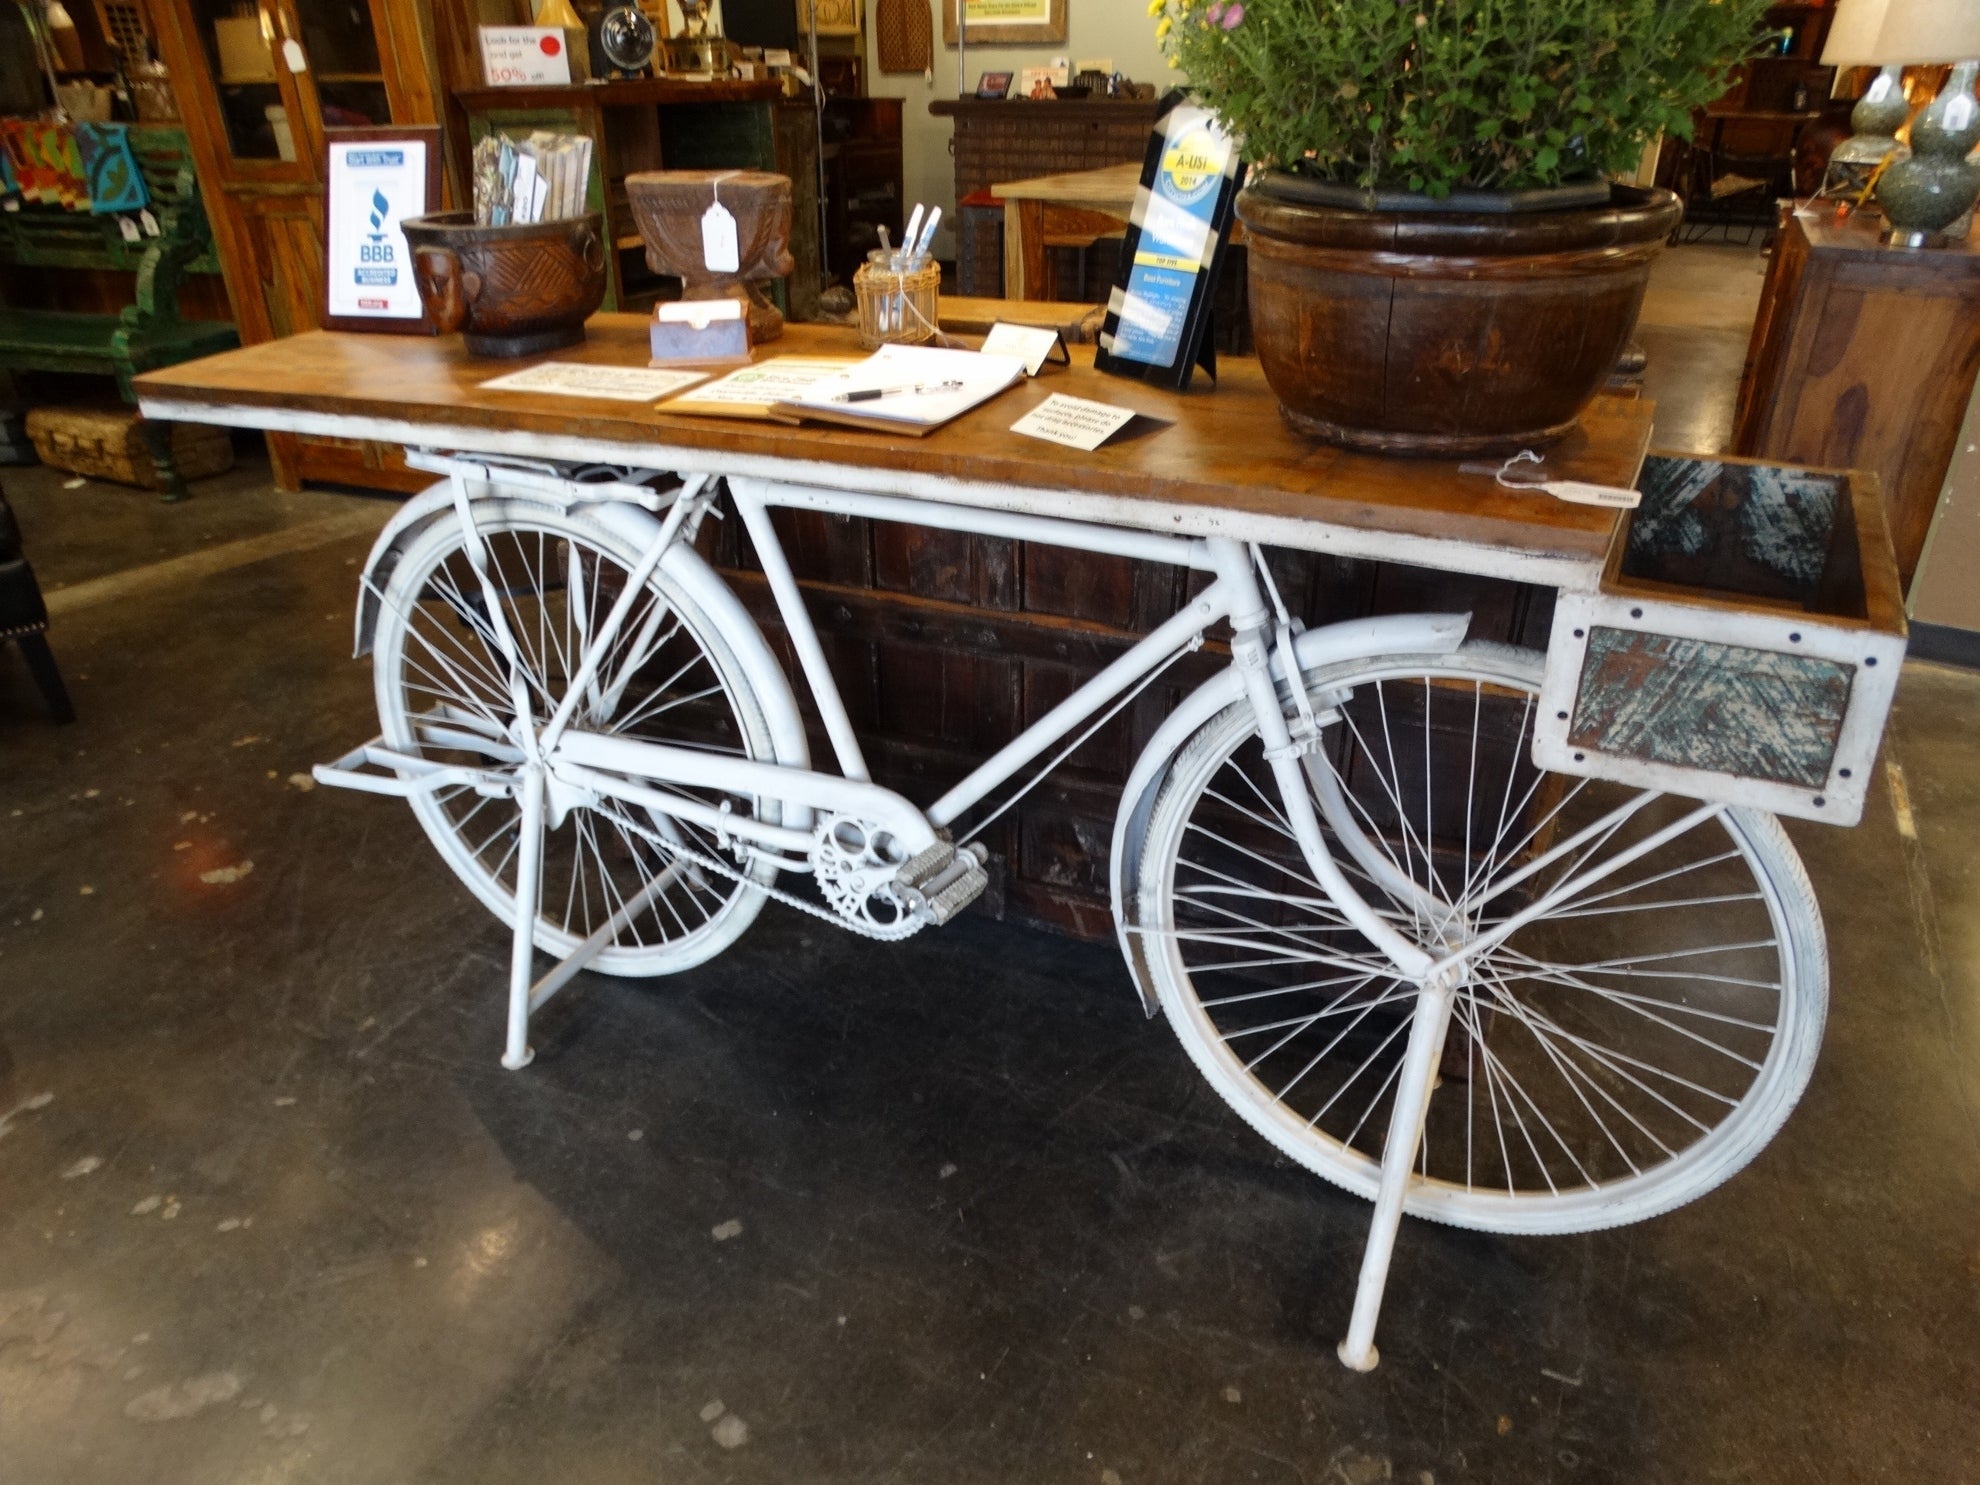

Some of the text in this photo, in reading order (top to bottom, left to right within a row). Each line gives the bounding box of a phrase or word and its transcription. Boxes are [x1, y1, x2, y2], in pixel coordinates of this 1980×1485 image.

[485, 36, 536, 45] Look for the
[491, 67, 526, 82] 50%
[1180, 175, 1198, 186] 2014
[361, 245, 394, 262] BBB
